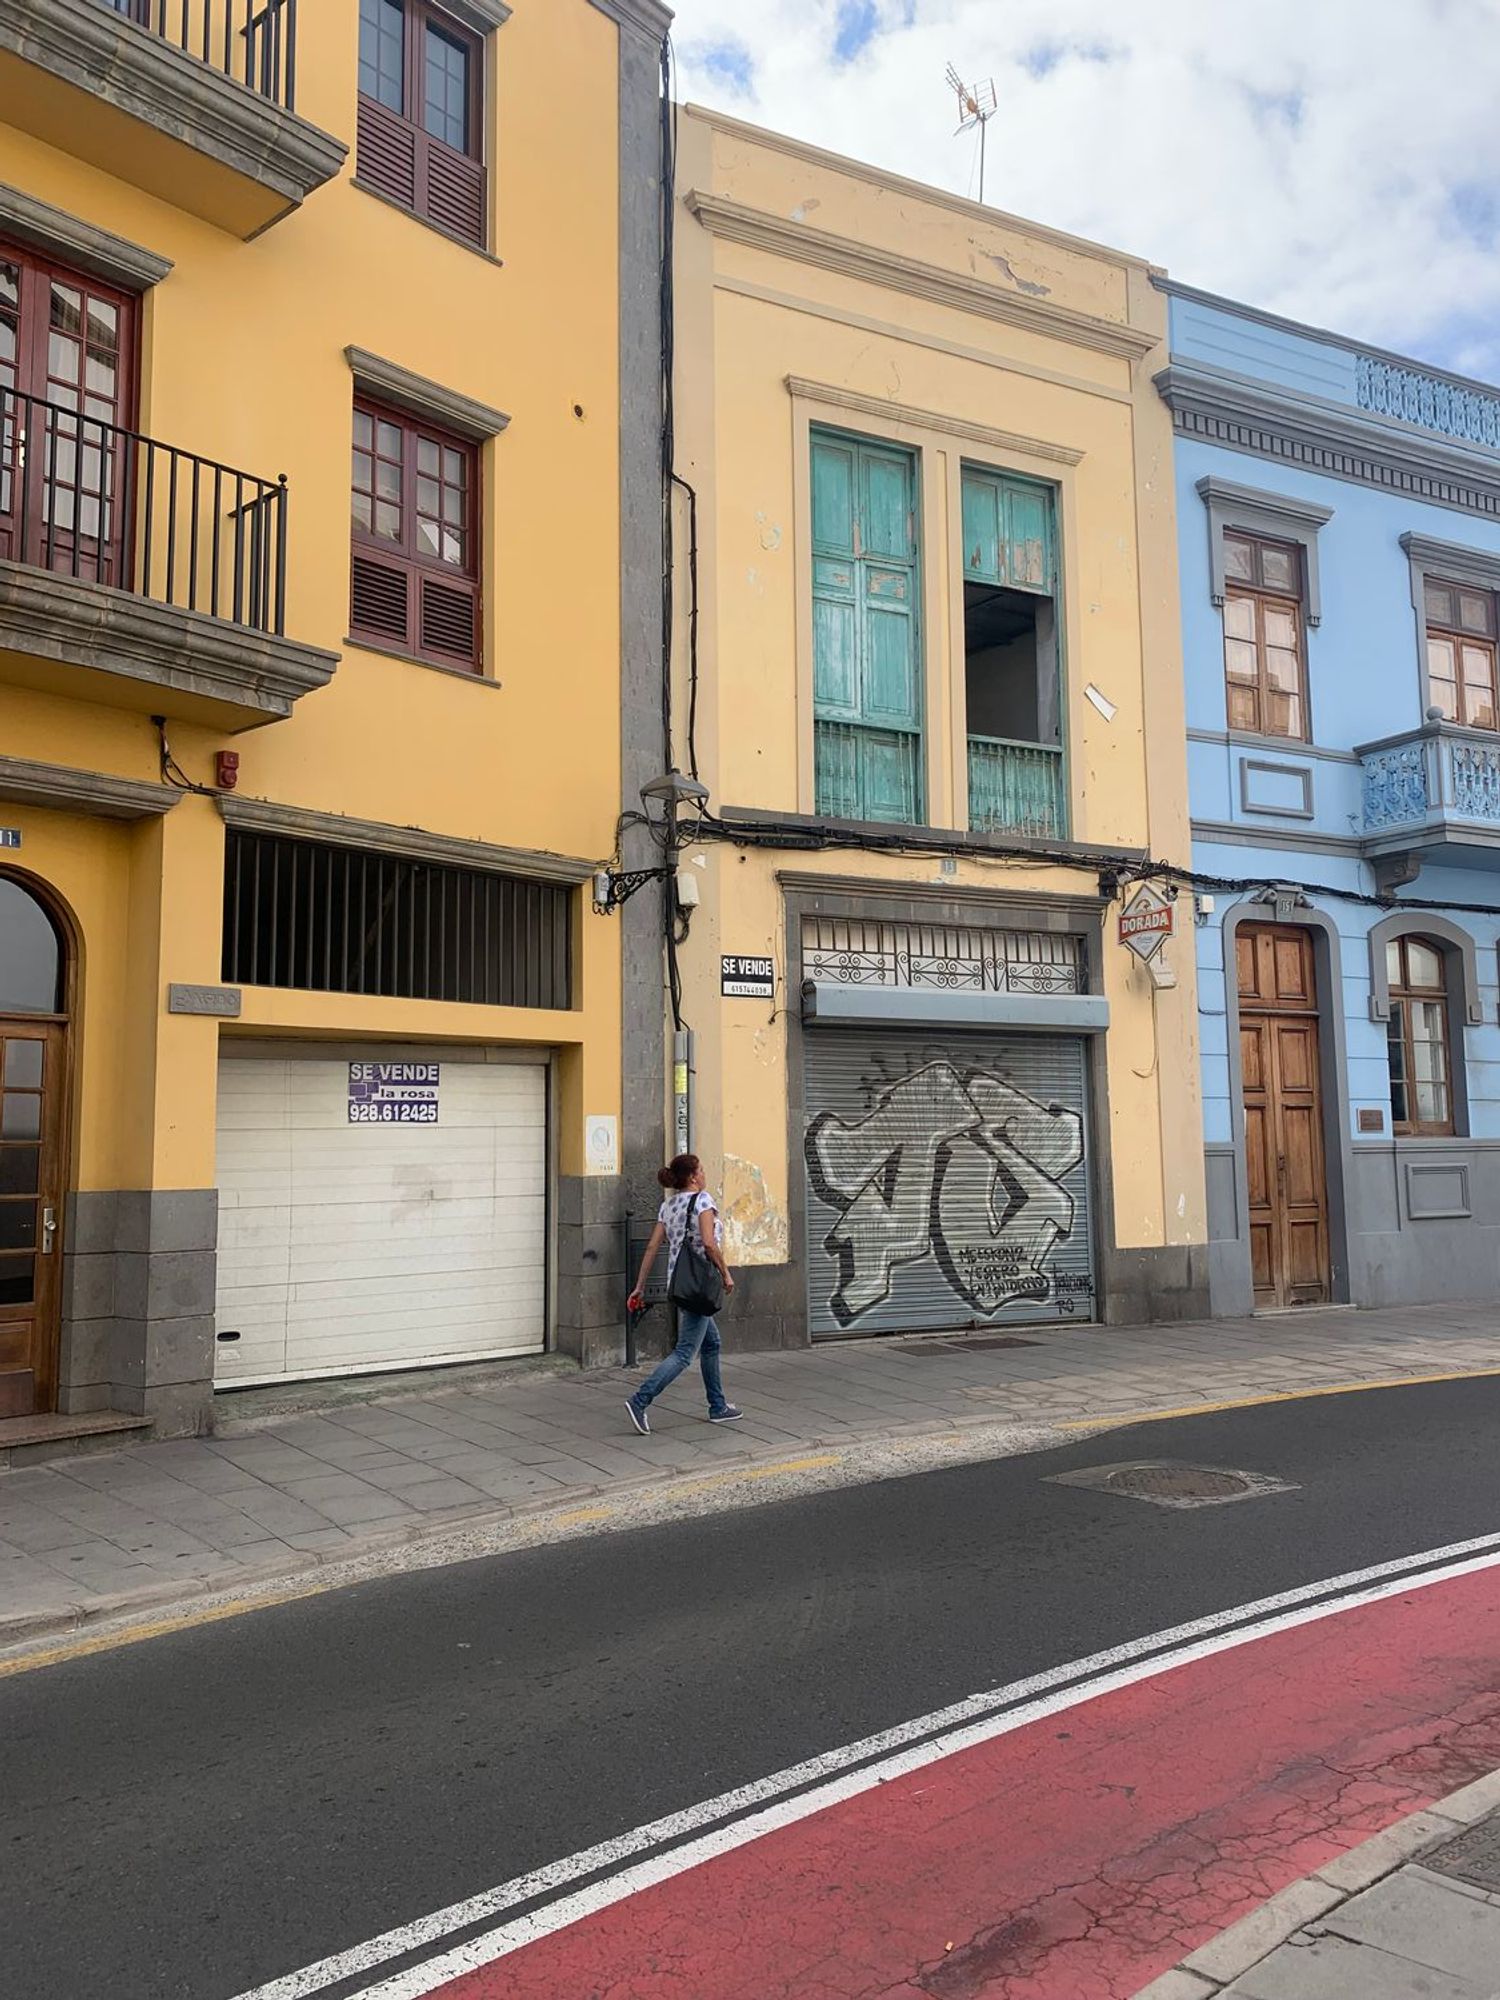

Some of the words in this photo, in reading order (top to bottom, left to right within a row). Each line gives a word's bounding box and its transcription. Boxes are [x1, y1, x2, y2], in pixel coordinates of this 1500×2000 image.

[1122, 912, 1169, 934] DORADA
[722, 958, 736, 974] SE
[738, 959, 772, 976] VENDE
[350, 1063, 374, 1080] SE
[379, 1064, 439, 1081] VENDE
[380, 1088, 395, 1098] la
[401, 1090, 435, 1099] rosa
[350, 1104, 437, 1121] 928.612425
